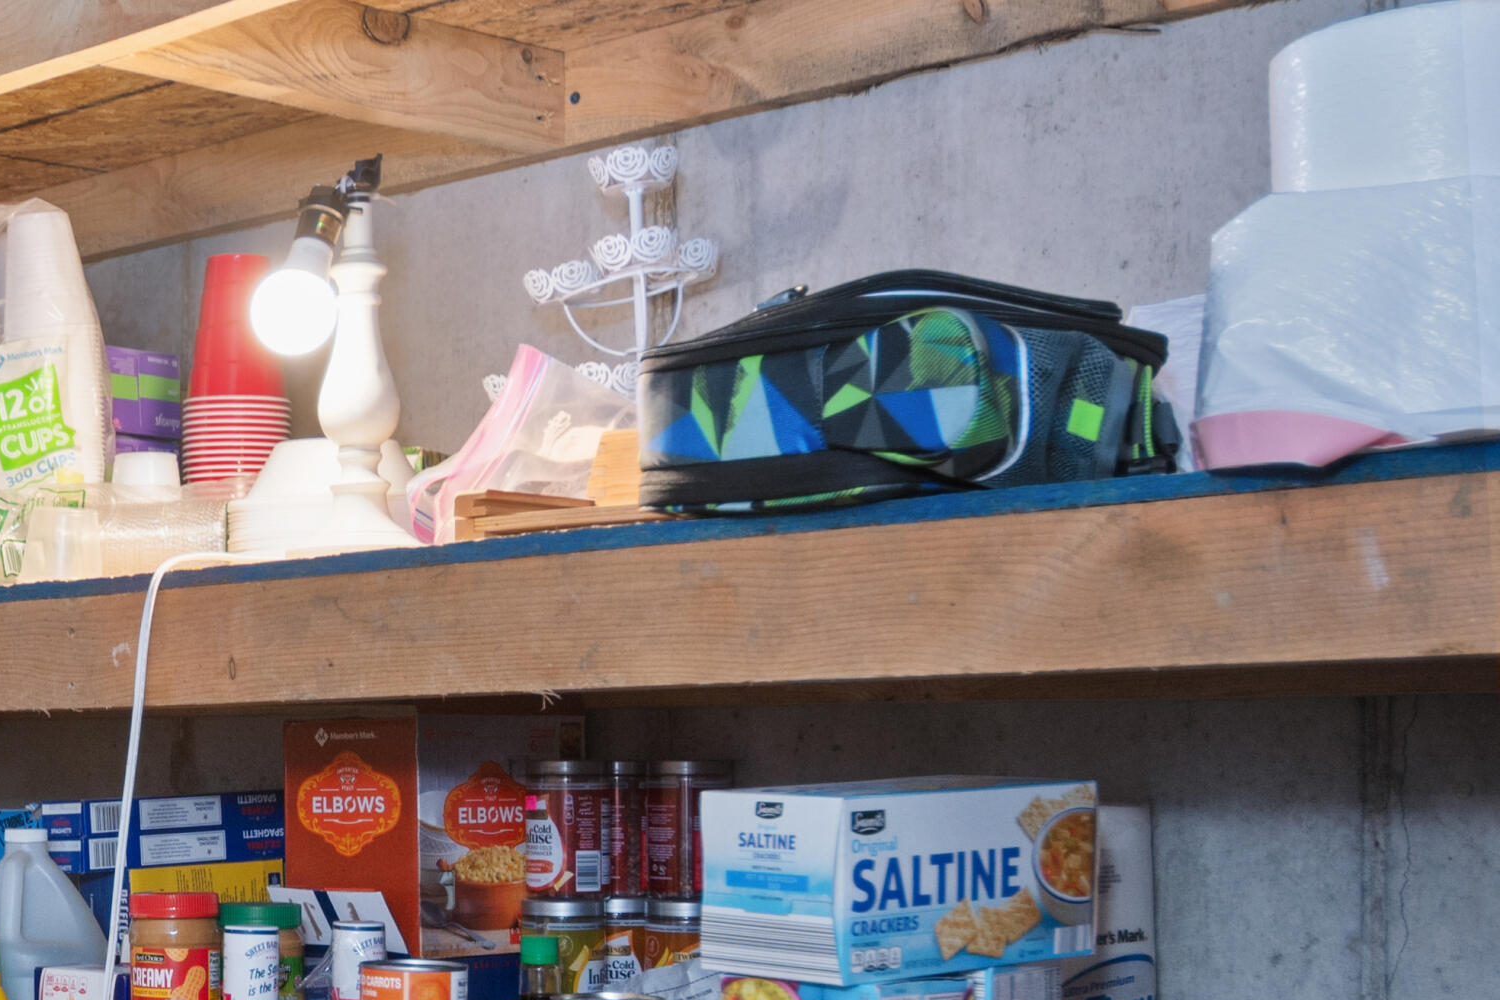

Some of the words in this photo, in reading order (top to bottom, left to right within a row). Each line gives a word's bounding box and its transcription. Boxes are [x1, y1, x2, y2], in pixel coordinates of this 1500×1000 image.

[0, 423, 71, 459] CUPS
[5, 467, 34, 488] 300
[35, 451, 77, 475] CUPS
[311, 796, 386, 814] ELBOWS
[457, 806, 524, 824] ELBOWS
[242, 827, 285, 840] SPAGHETTI
[738, 831, 797, 850] SALTINE
[851, 836, 899, 857] Original
[850, 846, 1021, 914] SALTINE
[851, 915, 920, 937] CRACKERS
[1117, 927, 1145, 945] Mark
[249, 967, 266, 981] The
[612, 960, 635, 971] Cold
[132, 966, 174, 988] CREAMY
[365, 976, 402, 990] CARROTS
[1089, 974, 1135, 993] Premium
[247, 985, 256, 997] is
[258, 983, 273, 994] the
